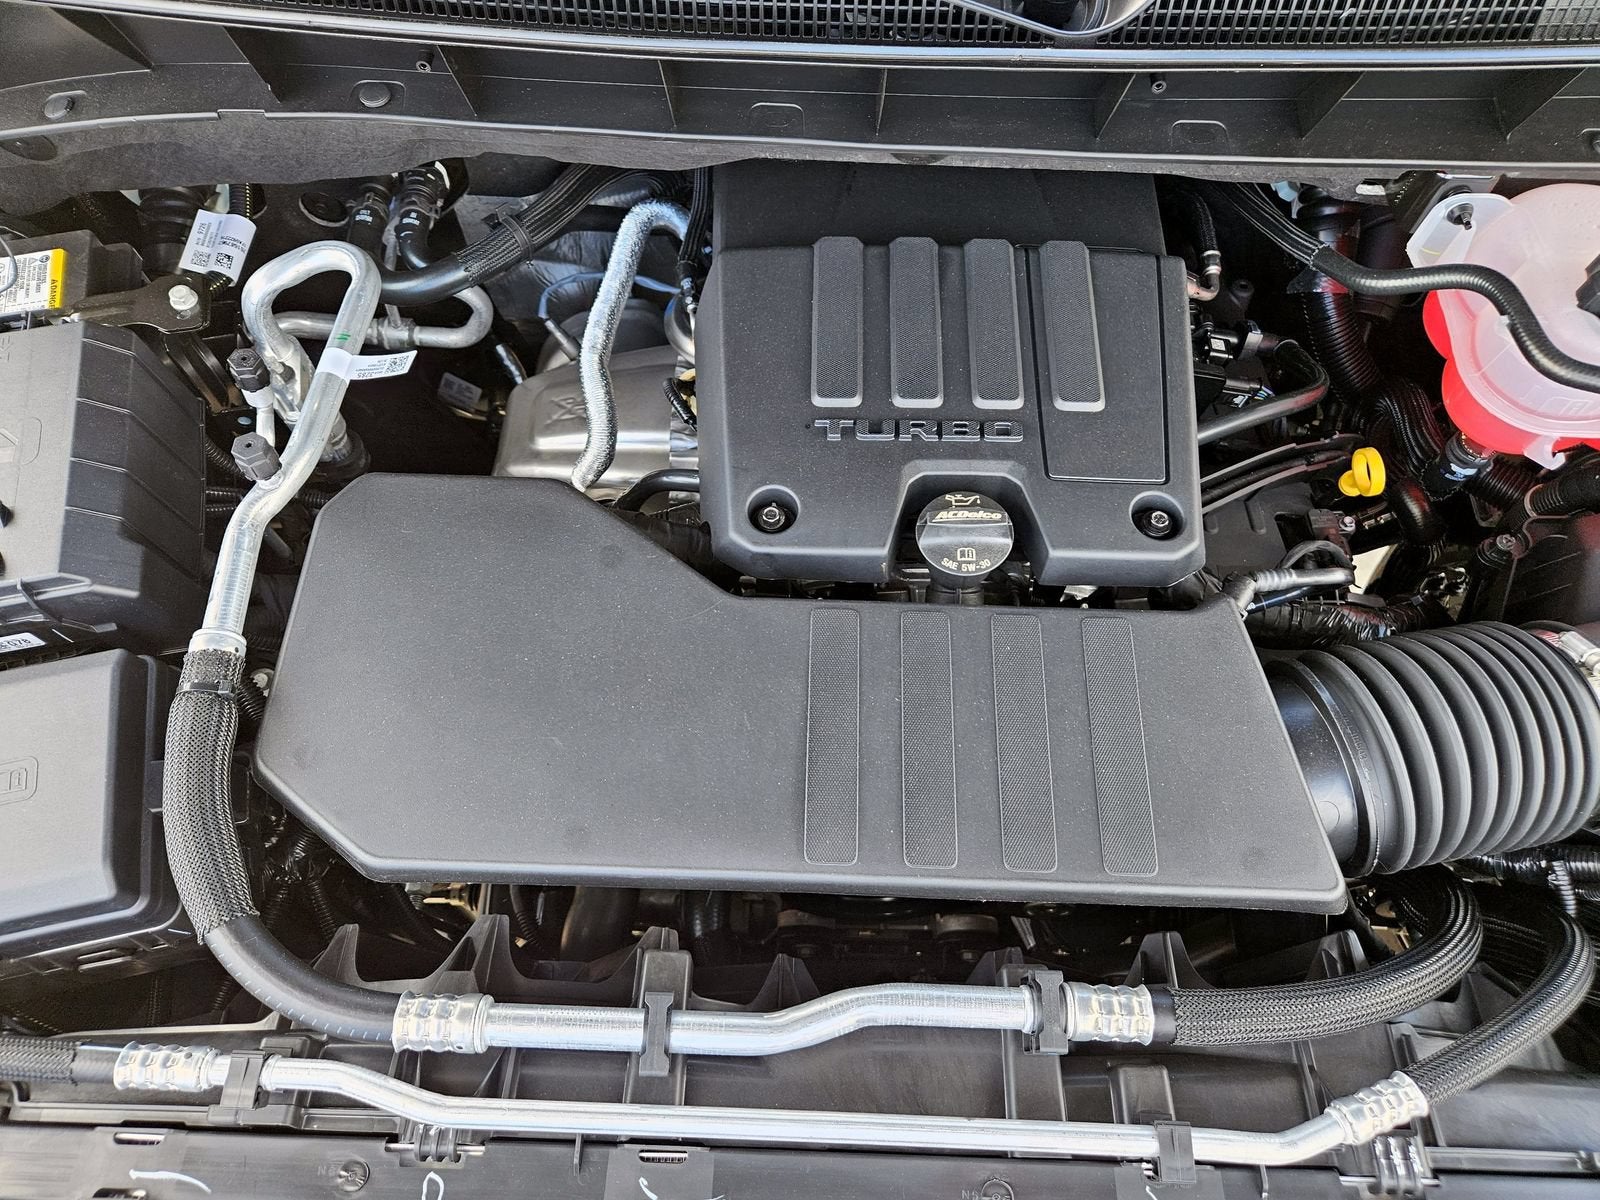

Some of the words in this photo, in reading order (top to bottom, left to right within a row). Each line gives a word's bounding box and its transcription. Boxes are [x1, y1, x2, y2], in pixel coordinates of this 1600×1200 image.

[814, 419, 1024, 442] TURBO
[934, 510, 1002, 520] ACDelco
[941, 557, 959, 571] SAE
[961, 559, 991, 572] 5W-30
